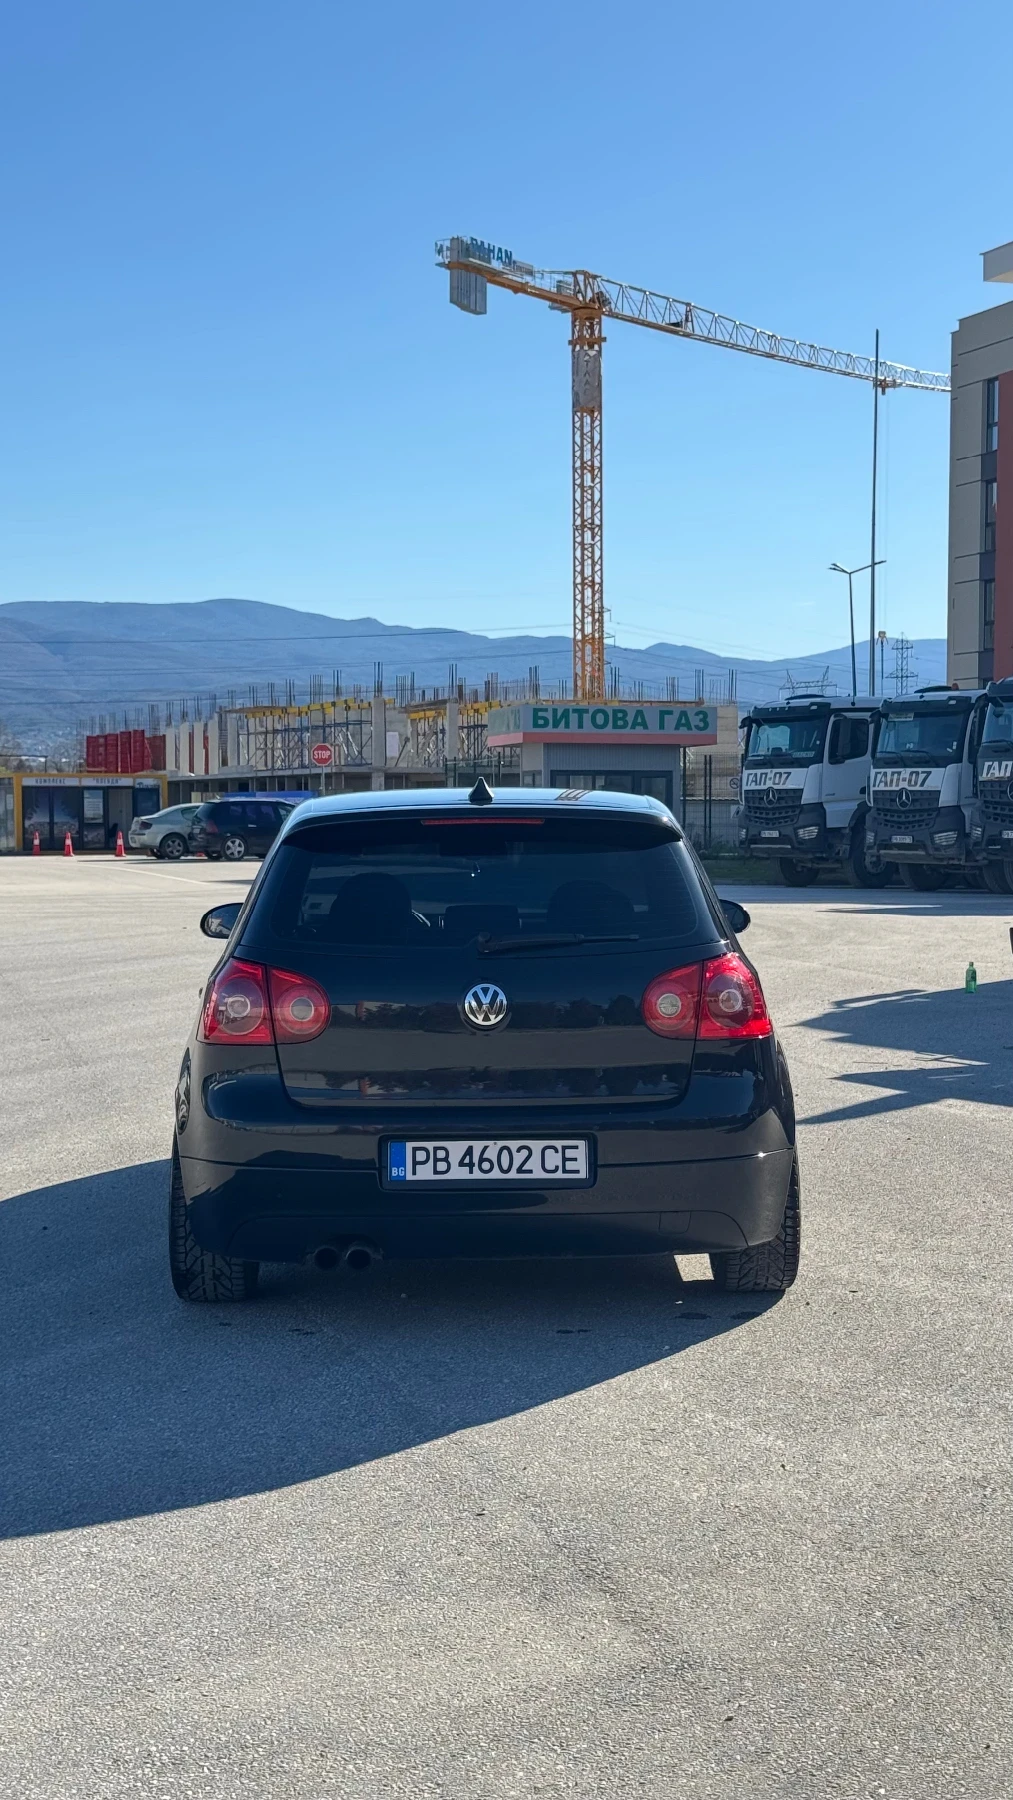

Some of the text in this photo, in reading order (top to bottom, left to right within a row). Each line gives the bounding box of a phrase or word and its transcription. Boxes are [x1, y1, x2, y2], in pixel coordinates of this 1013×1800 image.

[532, 707, 649, 730] БИТОВА
[658, 709, 710, 732] ГАЗ
[313, 750, 331, 759] STOP
[745, 772, 792, 786] ГАП-07
[872, 770, 932, 788] ГАП-07
[411, 1144, 581, 1176] PB 4602 CE
[391, 1167, 405, 1177] BG
